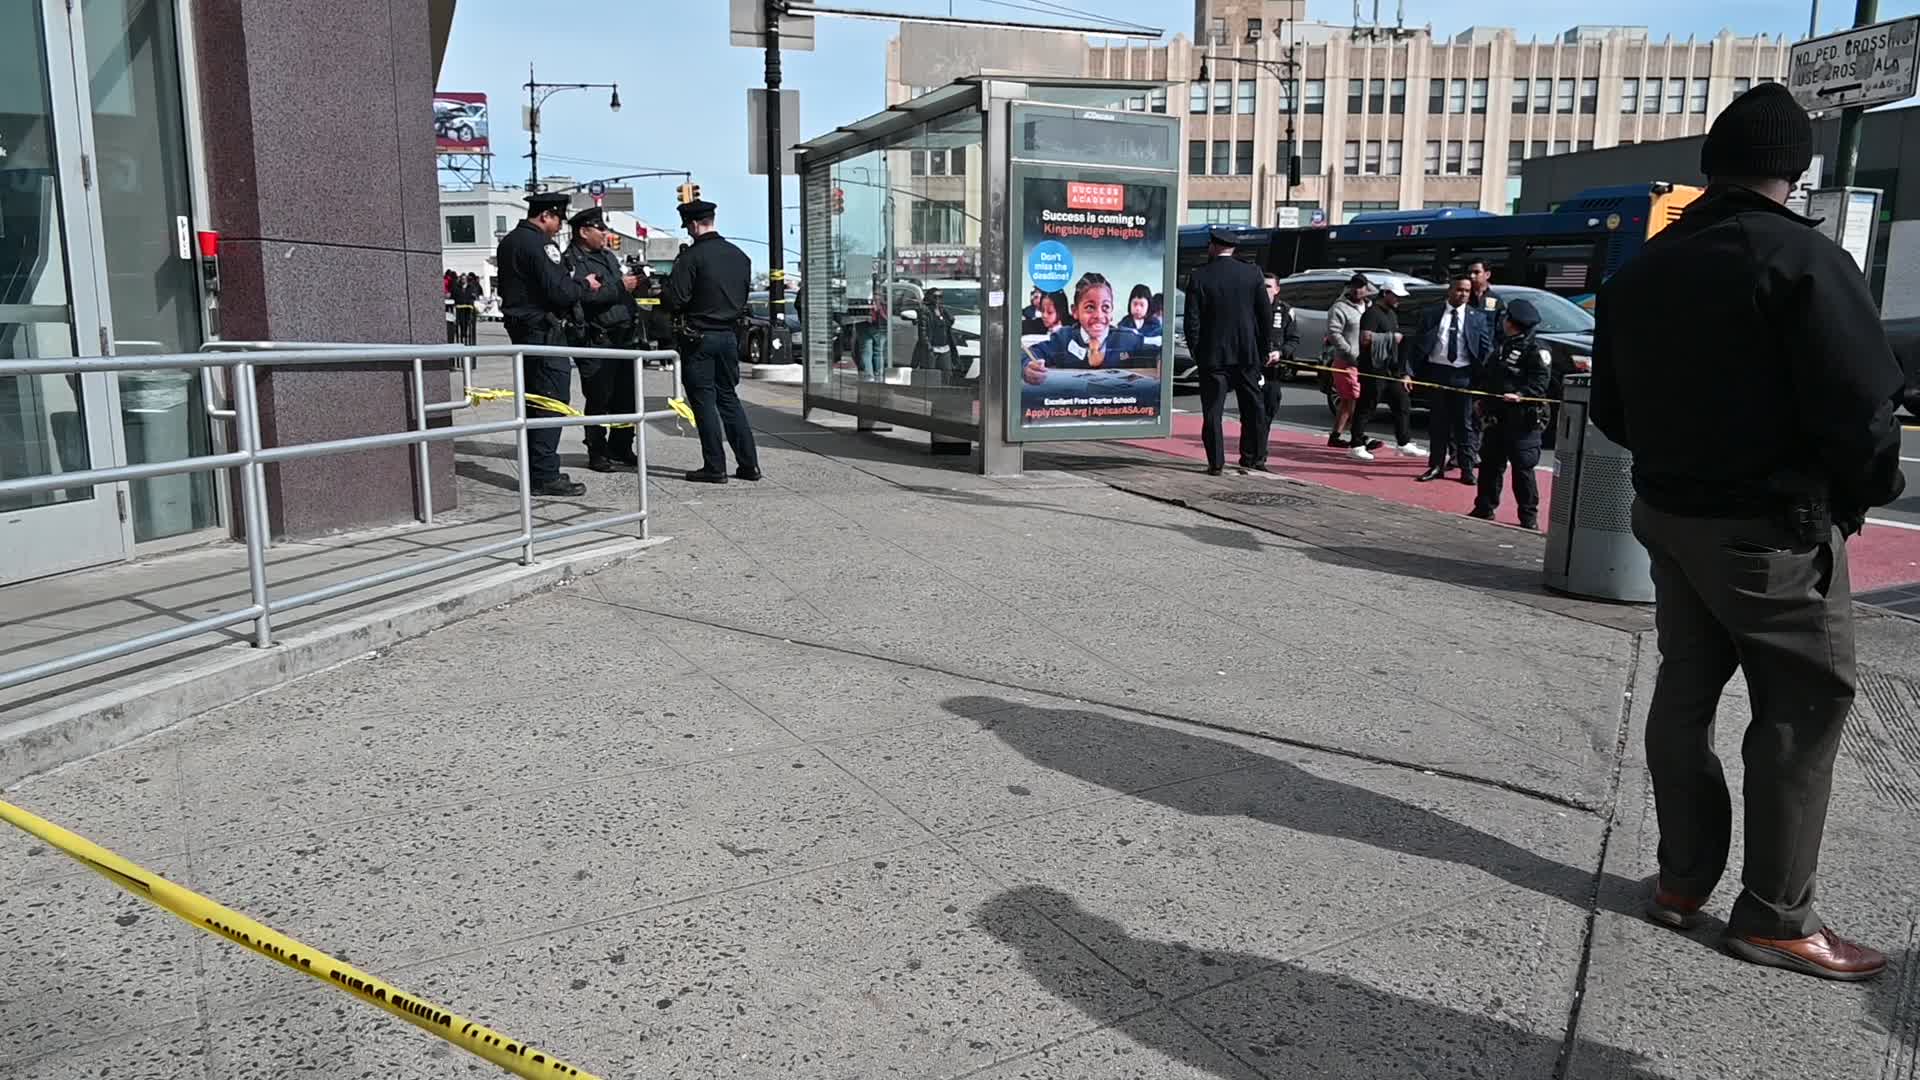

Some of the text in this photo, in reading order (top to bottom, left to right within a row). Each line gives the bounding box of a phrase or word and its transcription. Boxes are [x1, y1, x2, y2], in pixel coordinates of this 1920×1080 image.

[1796, 51, 1810, 67] NO
[1071, 185, 1120, 196] SUCCESS
[1071, 195, 1119, 205] ACADEMY
[1042, 209, 1146, 227] Success is coming to
[1044, 223, 1144, 240] Kingsbridge Heights
[1040, 252, 1062, 261] Don't
[1034, 262, 1068, 271] miss the
[1032, 271, 1070, 280] deadline!
[1044, 396, 1137, 406] Excellent Free Charter Schools
[1025, 406, 1088, 418] ApplyToSA.org
[1092, 405, 1154, 416] AplicarASA.org
